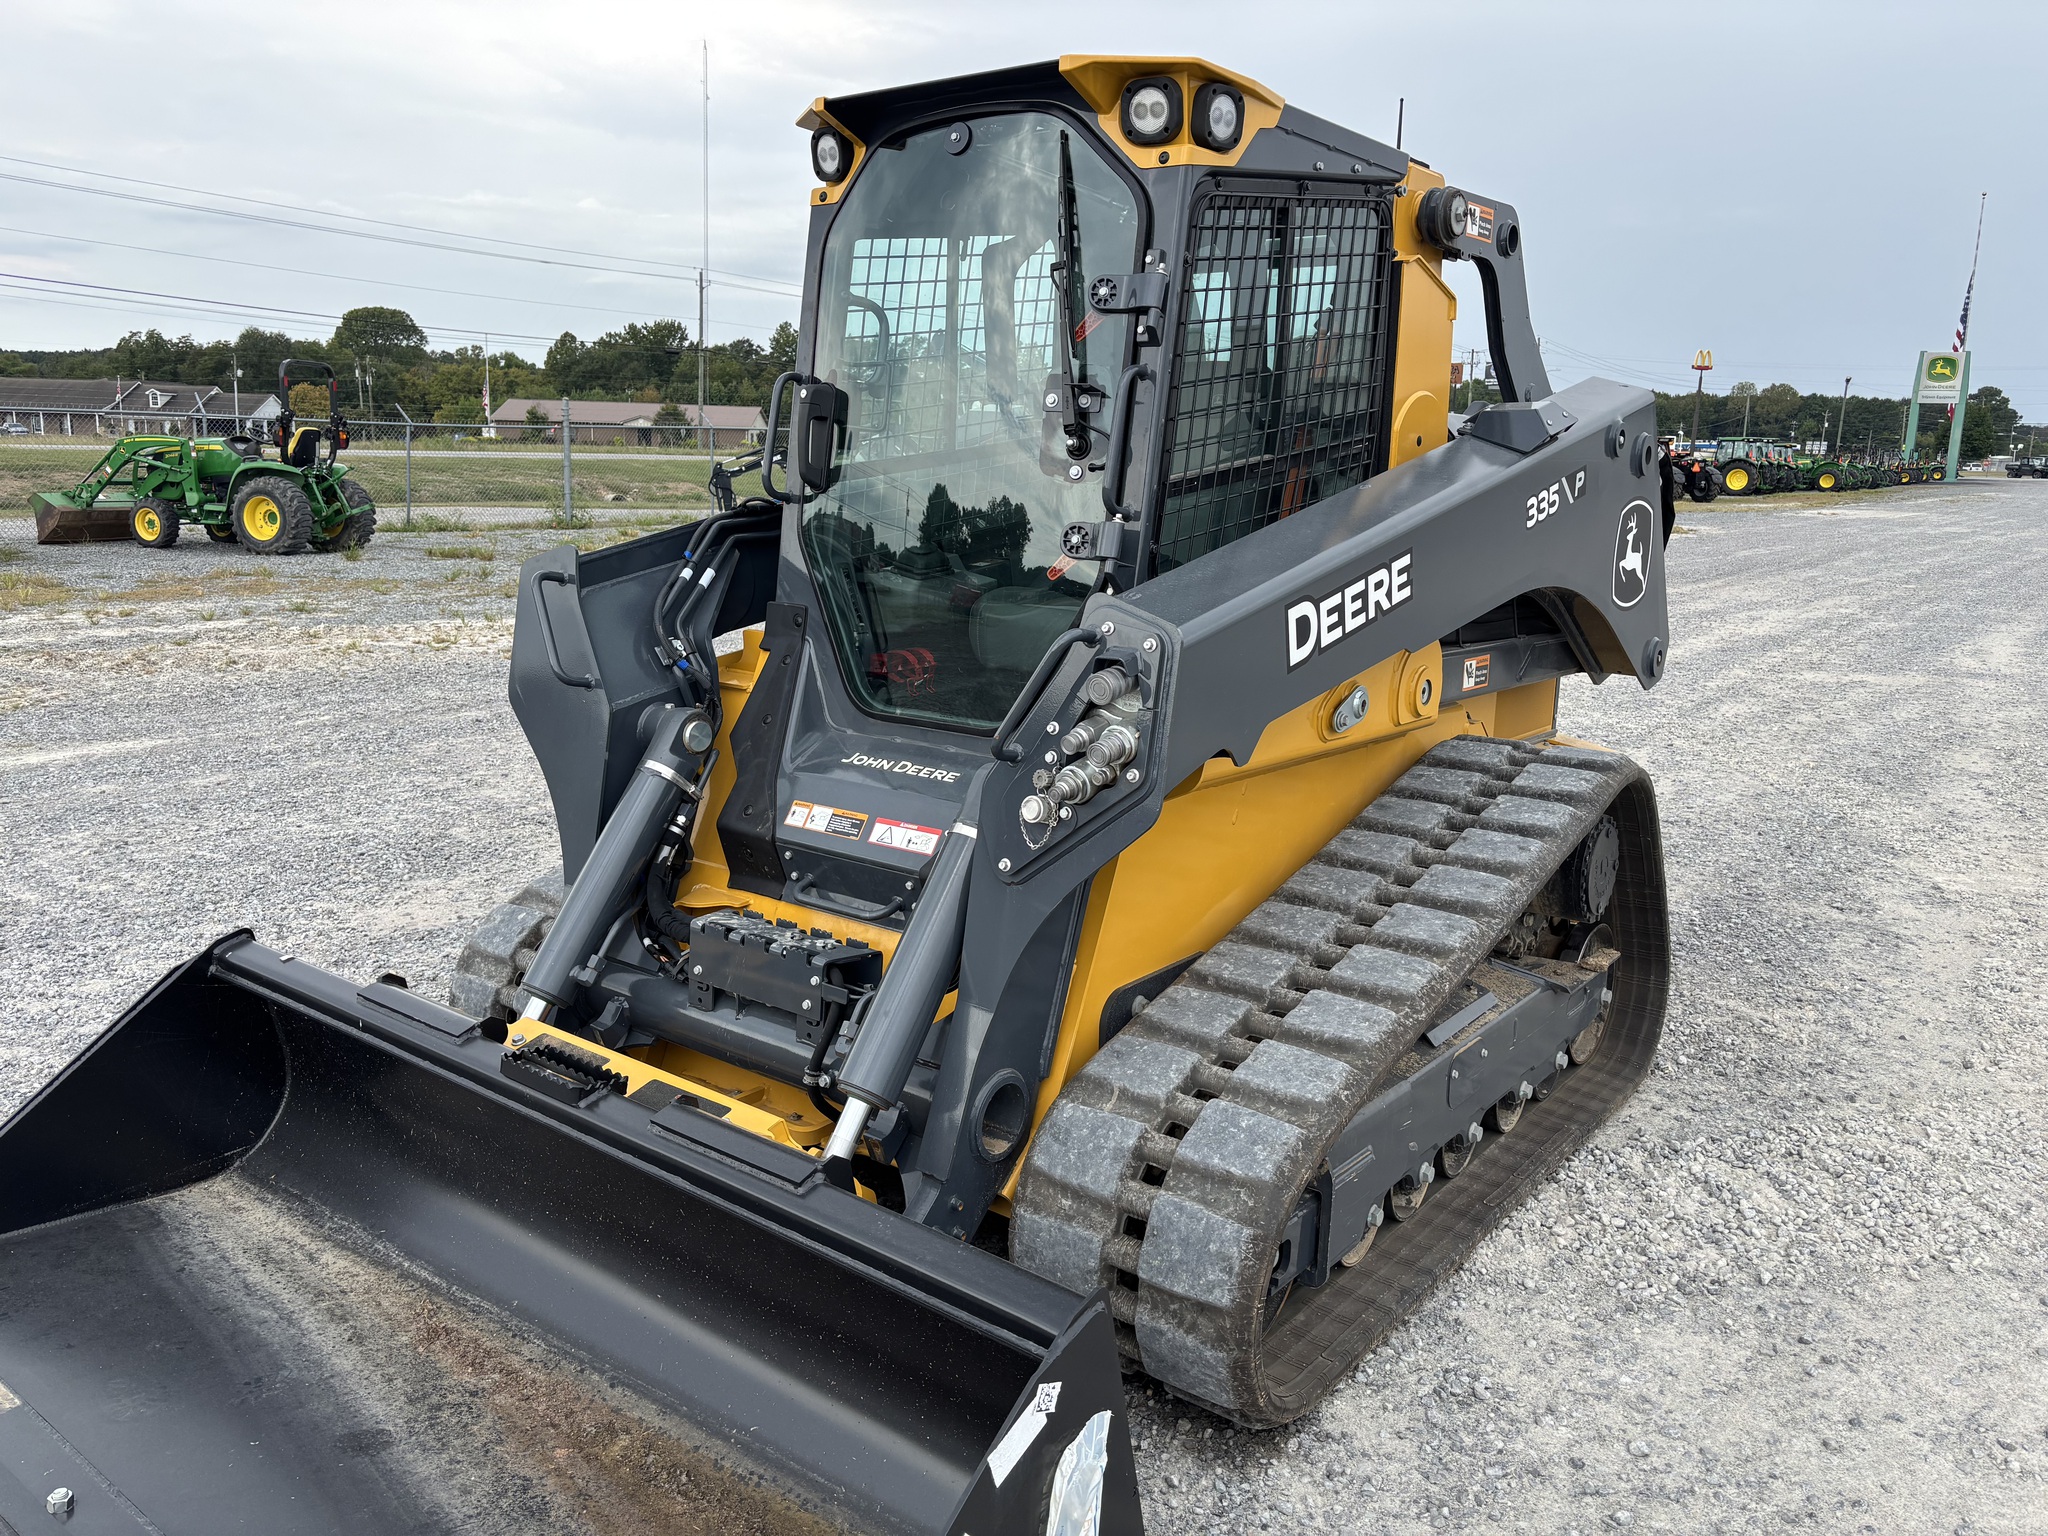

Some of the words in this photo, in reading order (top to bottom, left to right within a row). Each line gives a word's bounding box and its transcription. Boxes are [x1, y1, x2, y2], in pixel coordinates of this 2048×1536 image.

[1288, 553, 1411, 667] DEERE
[841, 752, 895, 770] JOHN
[893, 760, 961, 783] DEERE
